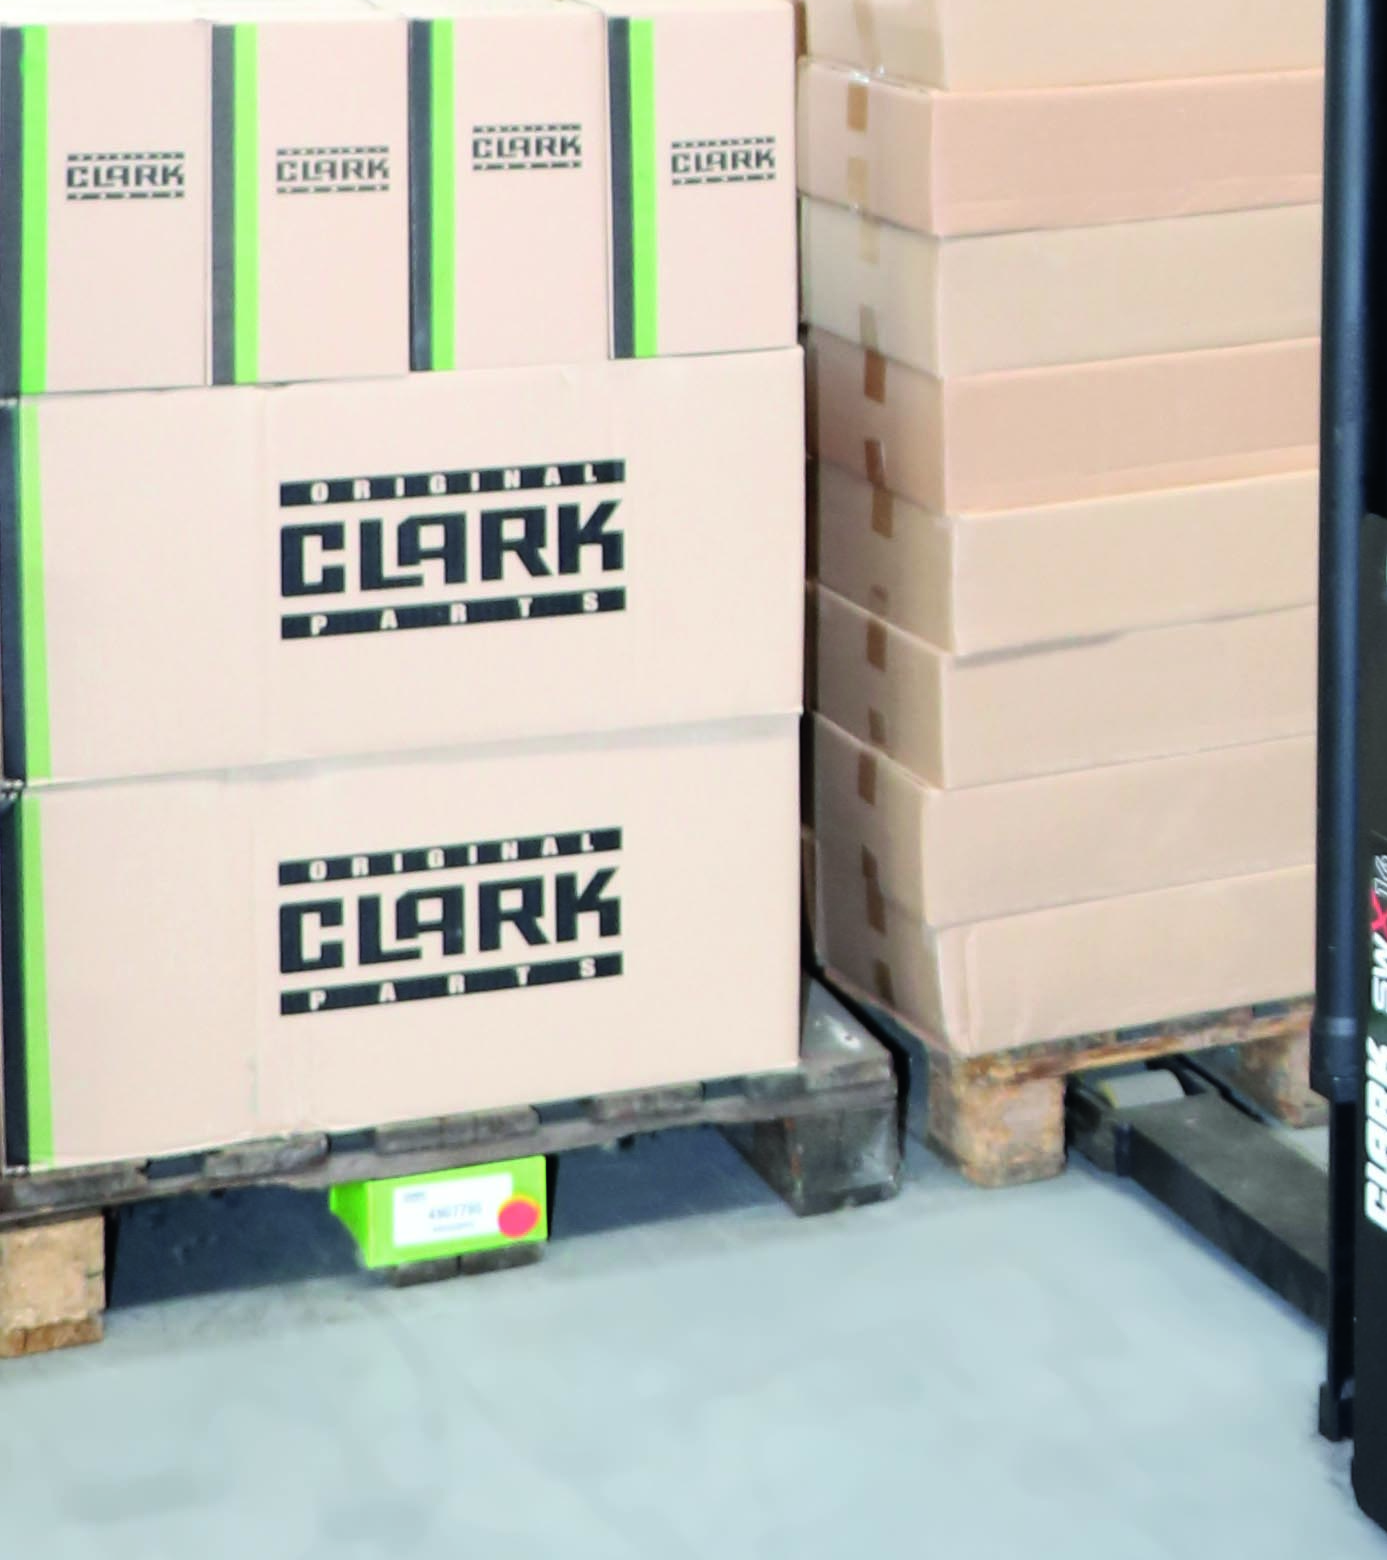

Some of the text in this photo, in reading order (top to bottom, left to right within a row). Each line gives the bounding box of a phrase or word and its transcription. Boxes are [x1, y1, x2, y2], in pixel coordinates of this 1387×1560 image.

[471, 133, 582, 160] CLARK
[671, 147, 776, 175] CLARK
[67, 163, 185, 189] CLARK
[276, 158, 389, 182] CLARK
[310, 463, 598, 503] ORIGINAL
[280, 498, 625, 598] CLARK
[309, 591, 599, 636] PARTS
[308, 832, 595, 880] ORIGINAL
[279, 865, 622, 974] CLARK
[308, 957, 597, 1011] PARTS
